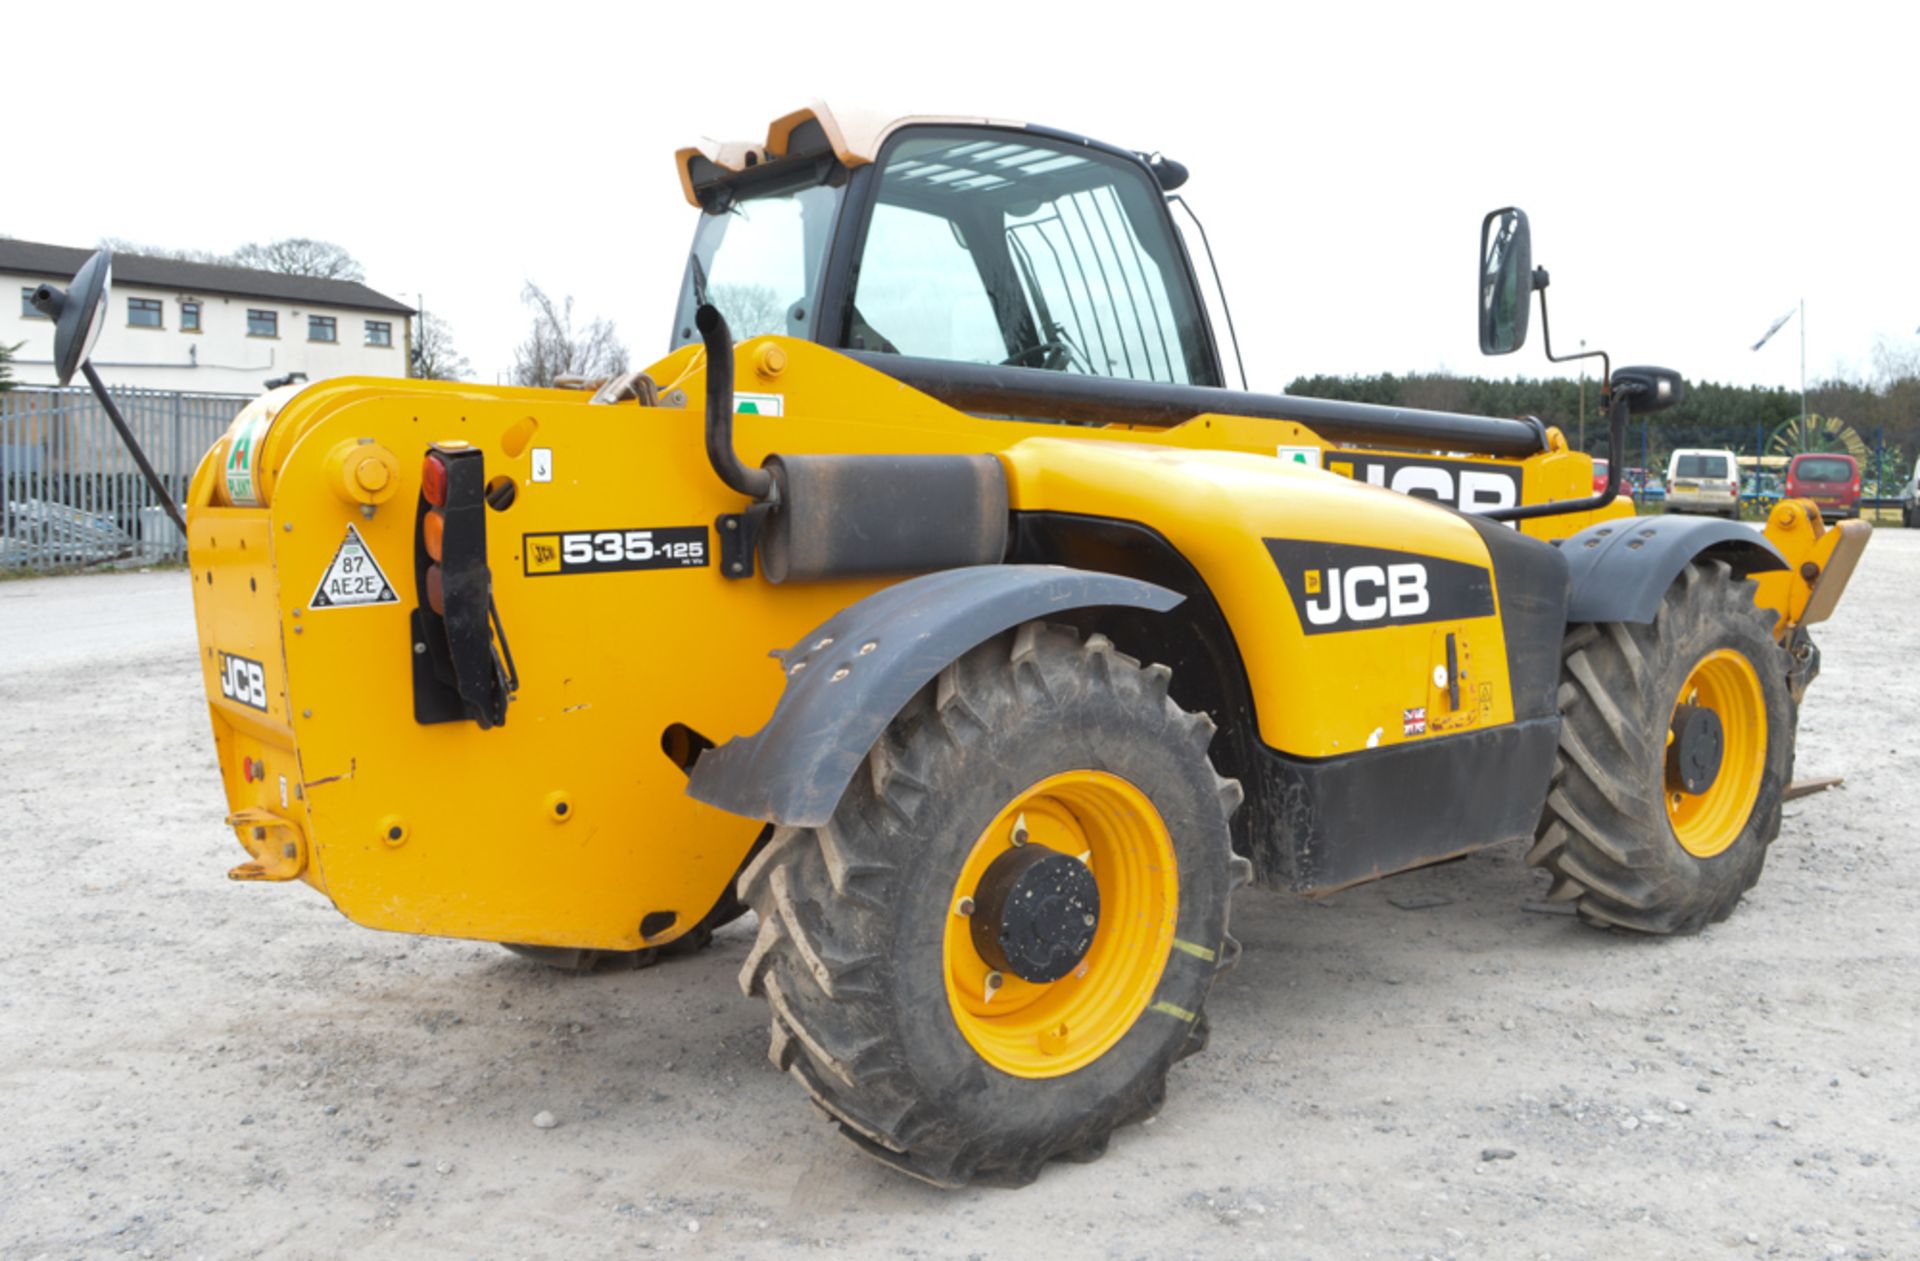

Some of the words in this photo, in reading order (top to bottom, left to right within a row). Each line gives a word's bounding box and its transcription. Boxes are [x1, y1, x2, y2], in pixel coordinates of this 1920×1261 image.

[562, 531, 704, 564] 535-125
[342, 556, 364, 574] 87
[330, 575, 377, 596] AE2E
[1305, 562, 1430, 626] JCB
[221, 655, 267, 708] JCB
